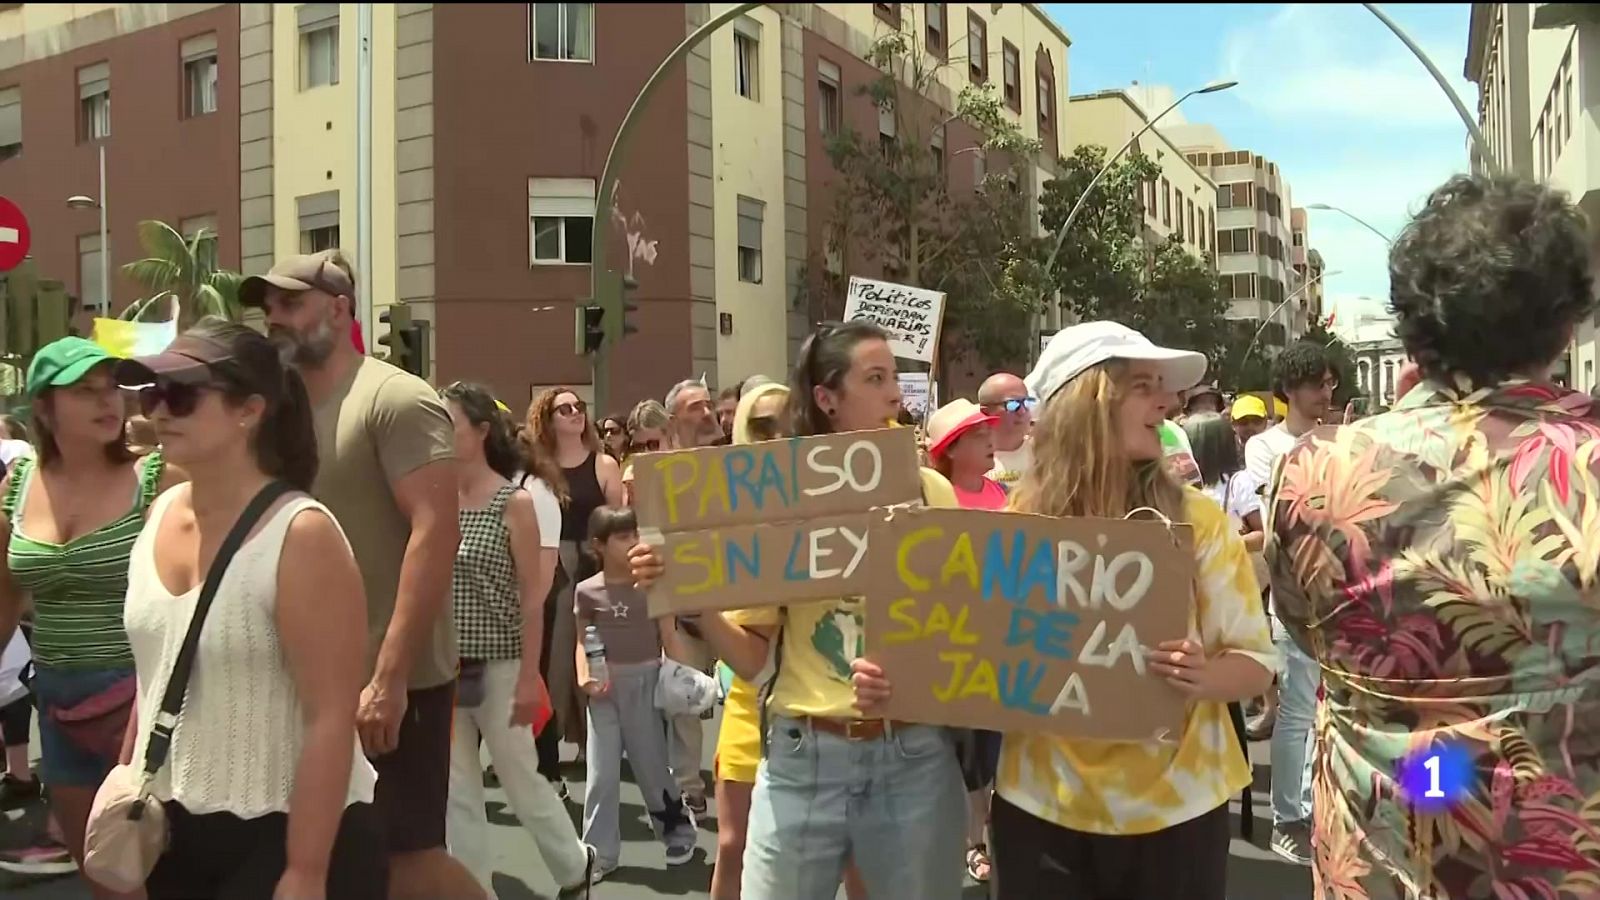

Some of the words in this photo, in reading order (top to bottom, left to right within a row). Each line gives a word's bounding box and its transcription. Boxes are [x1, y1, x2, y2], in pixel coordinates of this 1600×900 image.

[673, 531, 760, 595] SIN
[784, 526, 869, 583] LEY
[882, 598, 980, 645] SAL
[1005, 607, 1081, 660] DE
[1078, 620, 1149, 676] LA
[932, 652, 1090, 716] JAULA
